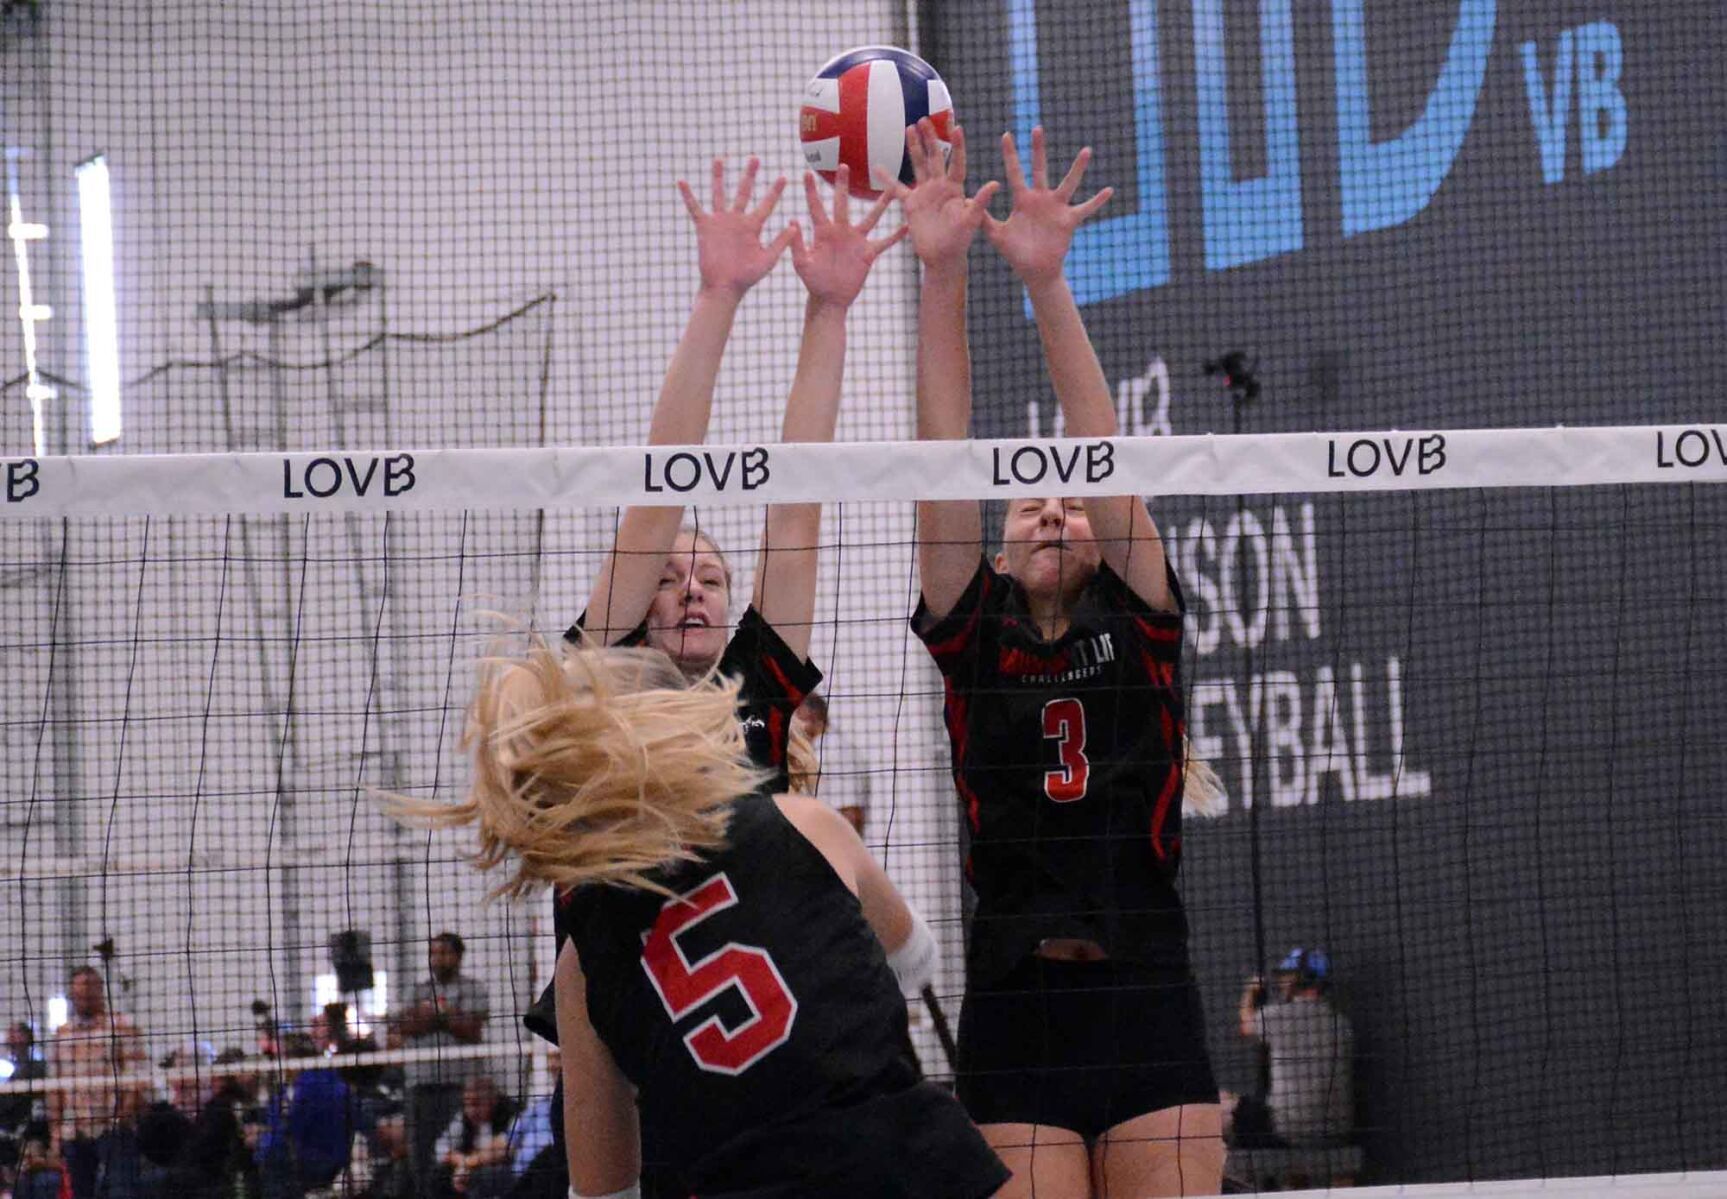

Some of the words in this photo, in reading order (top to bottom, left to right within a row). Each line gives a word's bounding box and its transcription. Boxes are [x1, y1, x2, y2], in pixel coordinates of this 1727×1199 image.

[1520, 20, 1628, 184] VB
[0, 459, 39, 502] B
[283, 453, 416, 498] LOVB
[645, 447, 770, 492] LOVB
[992, 441, 1115, 486] LOVB
[1328, 433, 1447, 478] LOVB
[1041, 697, 1090, 803] 3
[640, 871, 798, 1076] 5
